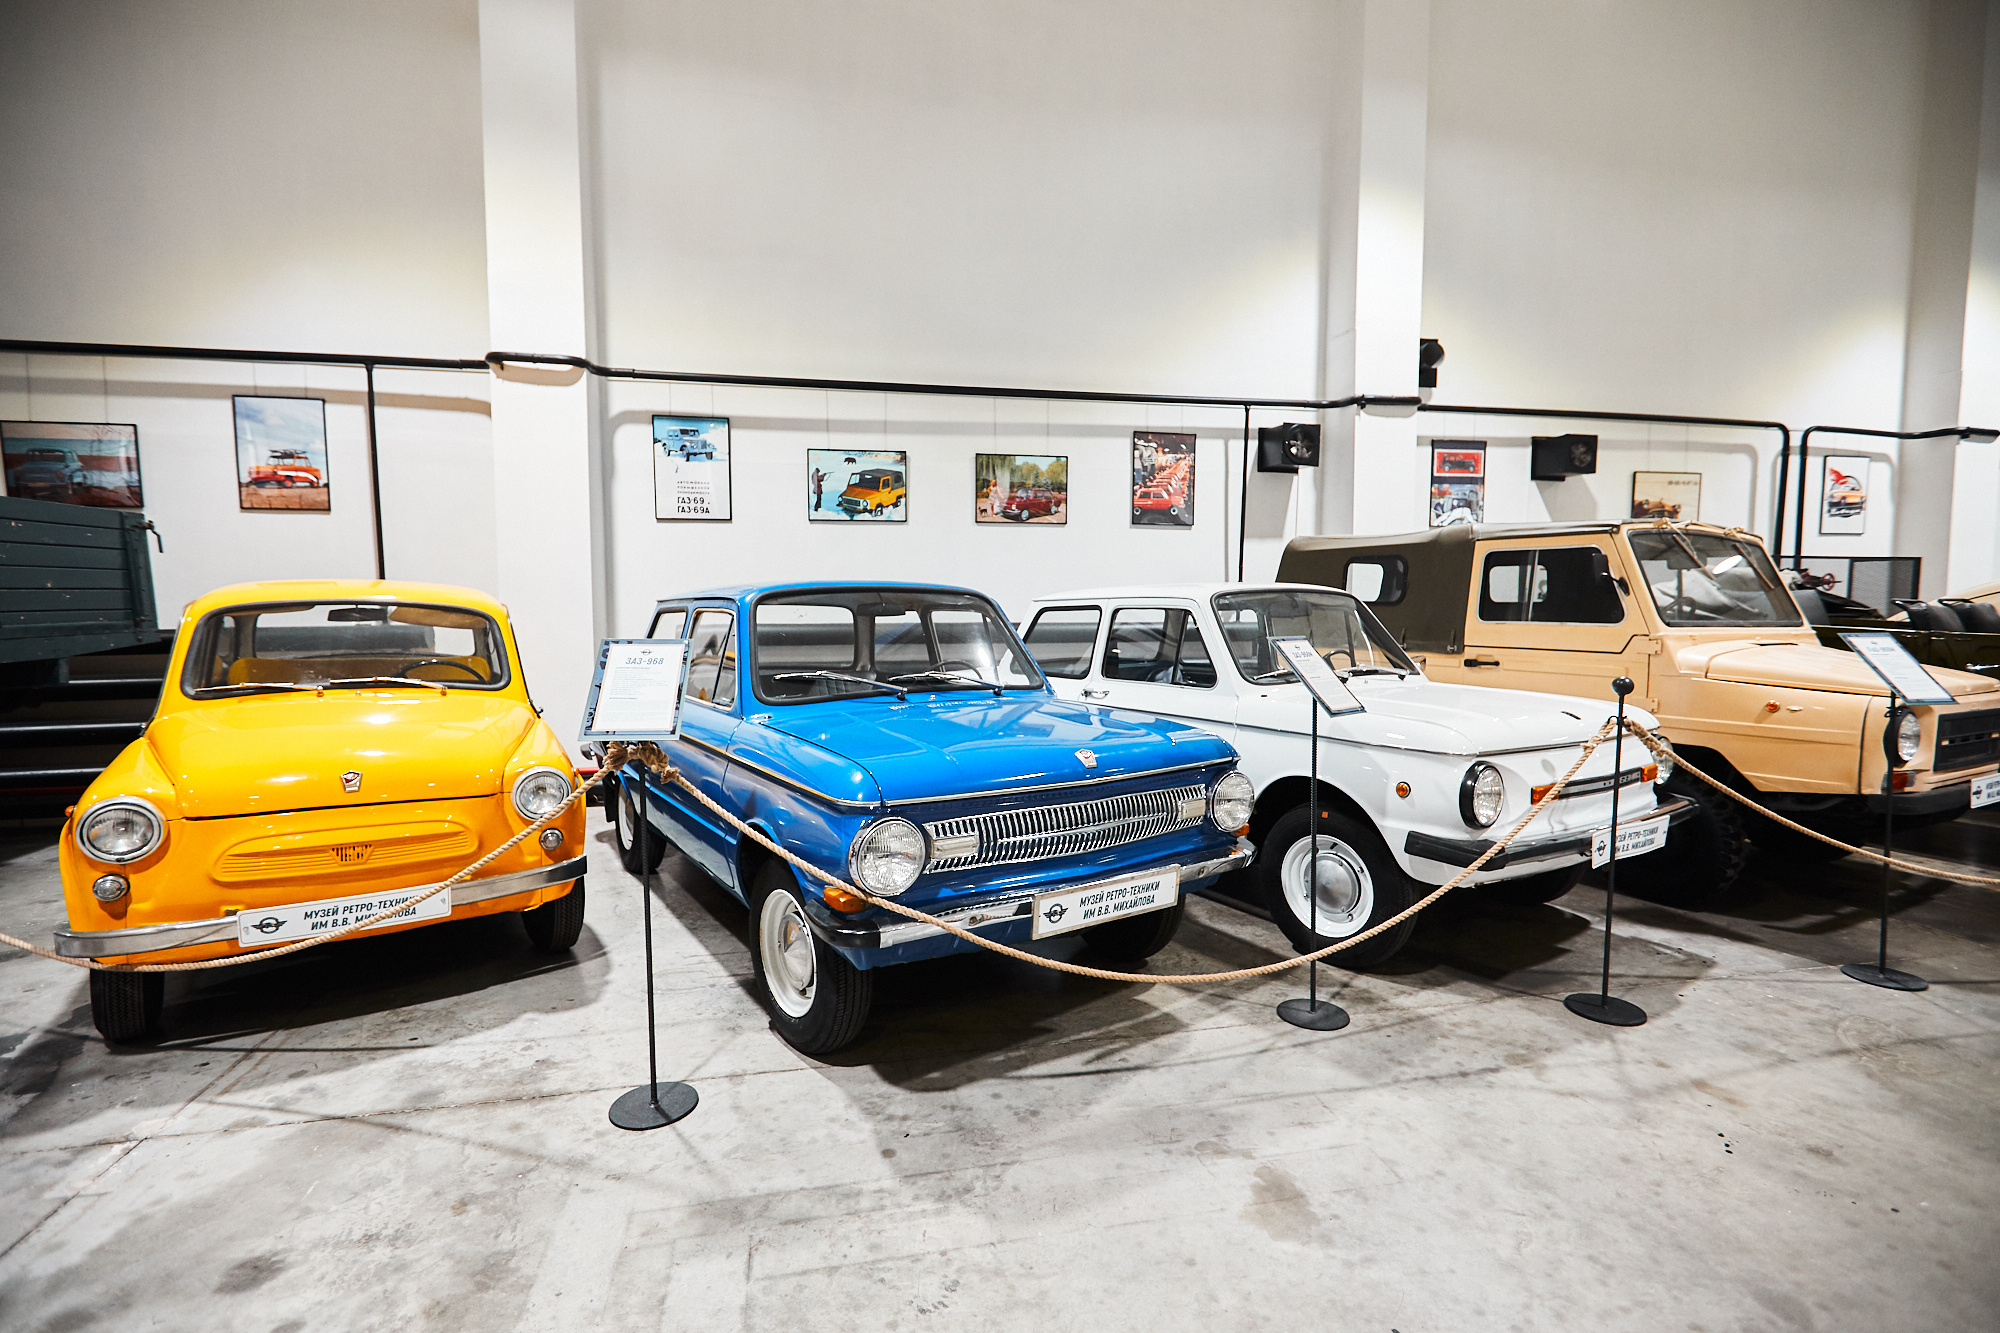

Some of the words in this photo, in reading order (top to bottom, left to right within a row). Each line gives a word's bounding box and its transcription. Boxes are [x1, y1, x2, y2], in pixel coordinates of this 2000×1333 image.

[625, 657, 664, 665] ЗАЗ-968
[1079, 890, 1104, 907] МУЗЕЙ
[1105, 881, 1160, 902] РЕТРО-ТЕХНИКИ
[304, 905, 339, 920] МУЗЕЙ
[342, 895, 418, 915] РЕТРО-ТЕХНИ
[1083, 908, 1096, 920] ИМ
[1097, 905, 1111, 917] В.В.
[1112, 894, 1155, 912] МИХАЙЛОВА
[311, 920, 328, 931] ИМ
[331, 917, 351, 928] В.В.
